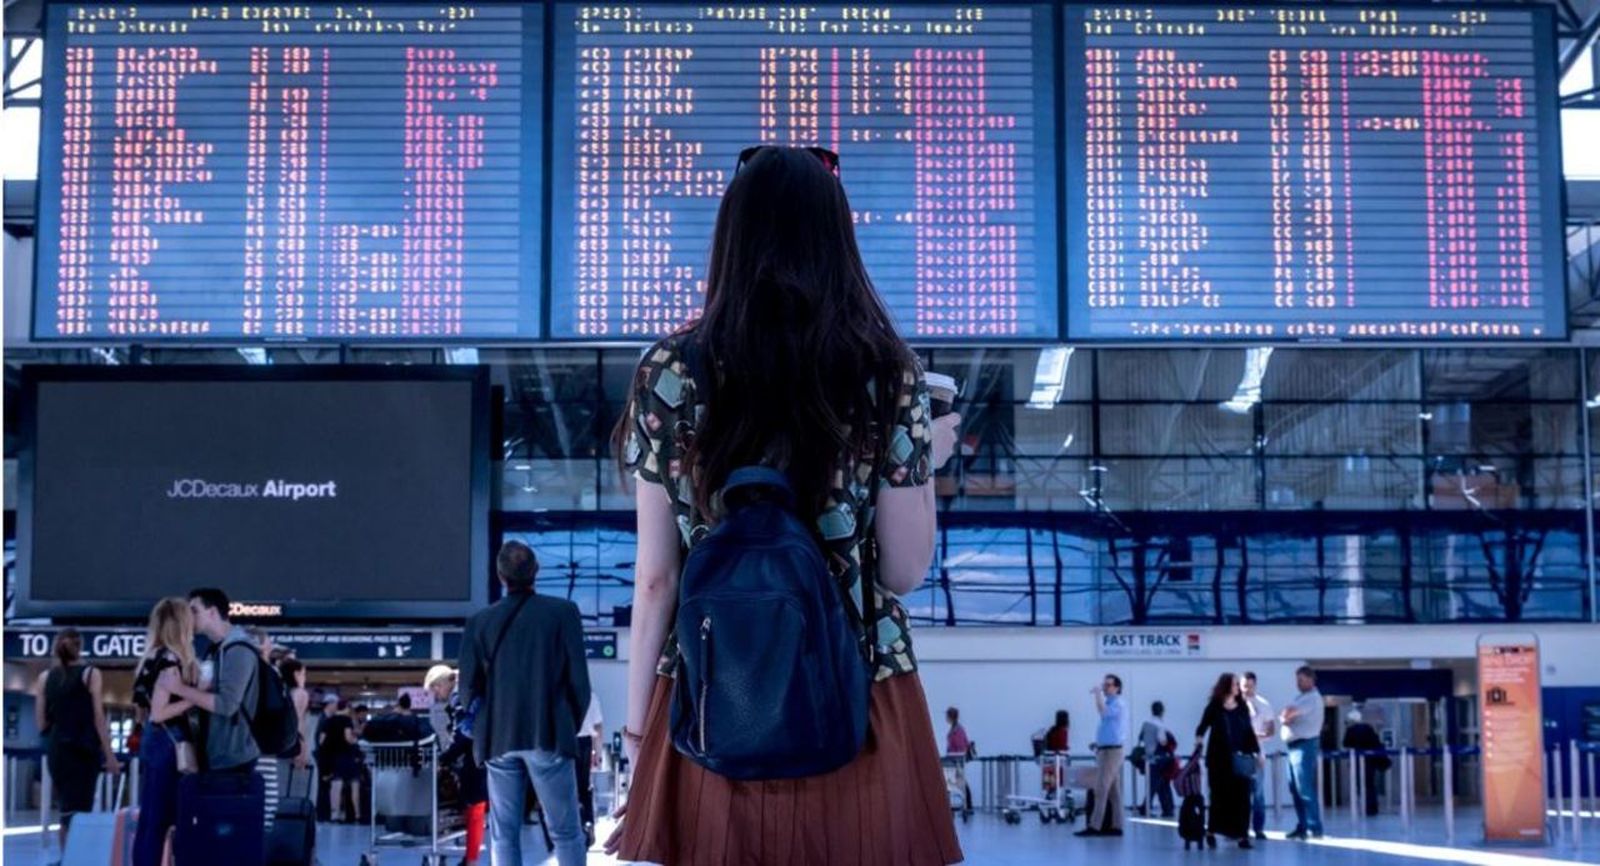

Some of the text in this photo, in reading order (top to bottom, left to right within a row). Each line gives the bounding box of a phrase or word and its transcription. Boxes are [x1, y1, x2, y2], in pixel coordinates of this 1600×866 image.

[167, 479, 336, 500] JCDecaux Airport
[19, 634, 49, 656] TO
[1103, 634, 1181, 646] FAST TRACK
